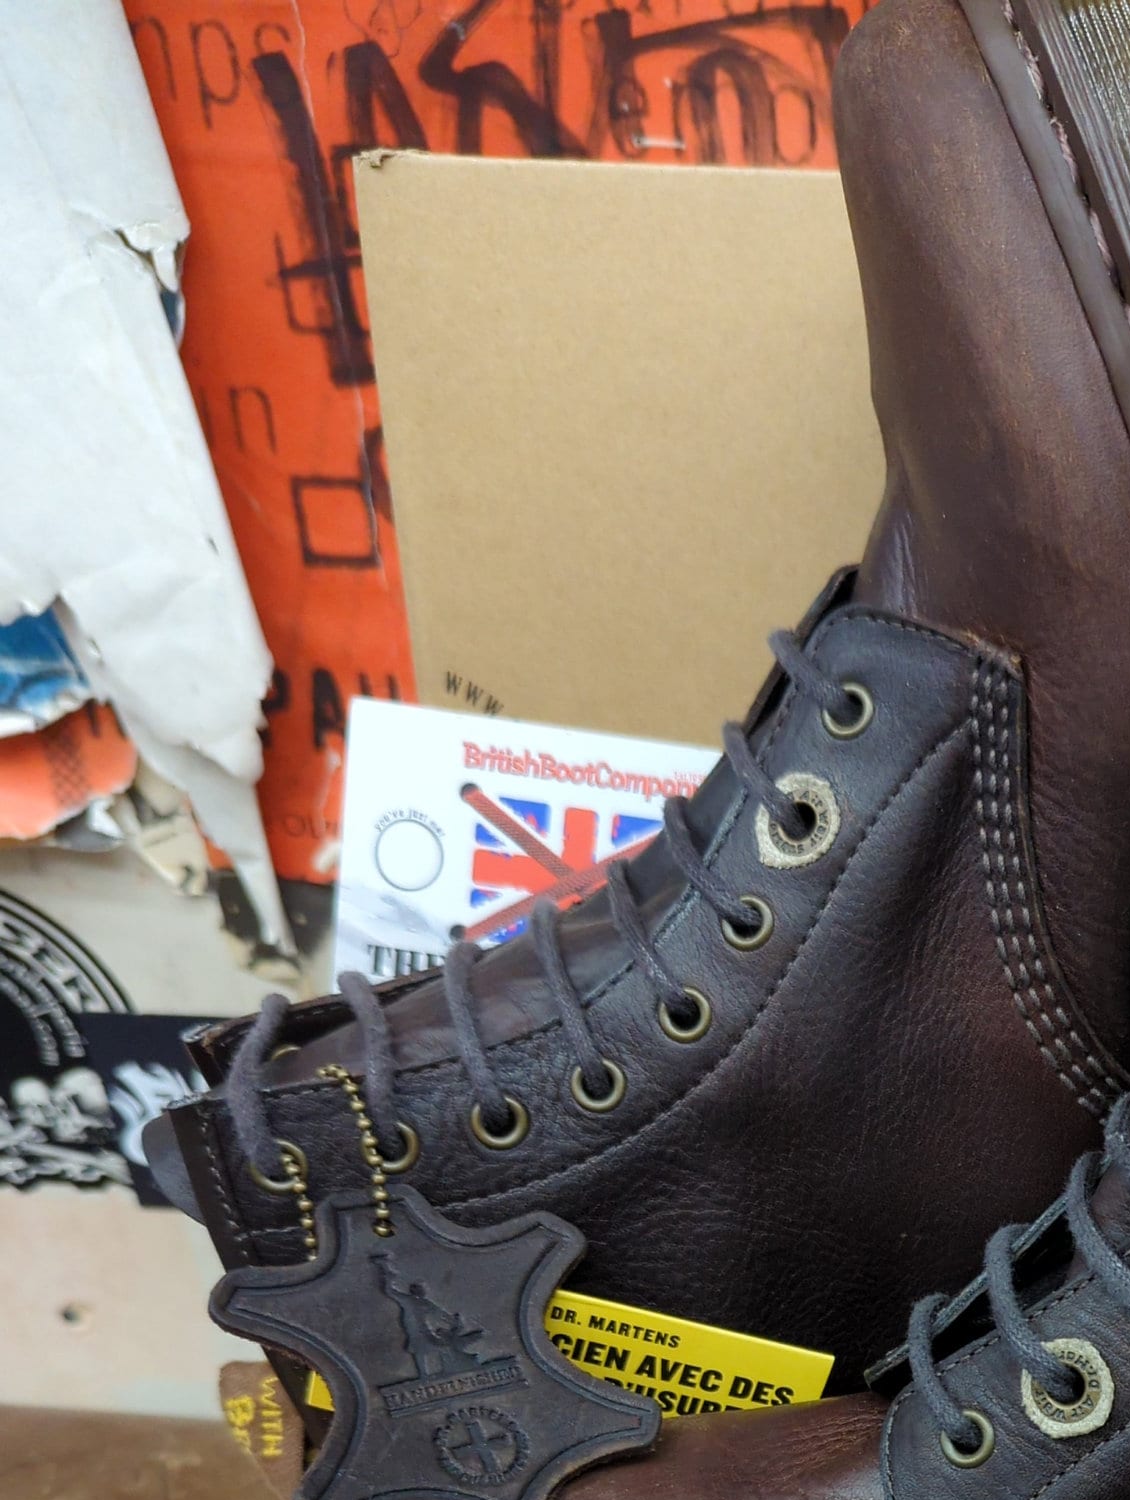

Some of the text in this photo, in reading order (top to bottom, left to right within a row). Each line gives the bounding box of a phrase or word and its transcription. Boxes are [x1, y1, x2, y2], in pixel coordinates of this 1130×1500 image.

[463, 741, 700, 802] BritishBootCompan
[550, 1306, 681, 1348] DR. MARTENS
[634, 1355, 723, 1393] AVEC
[728, 1375, 795, 1407] DES
